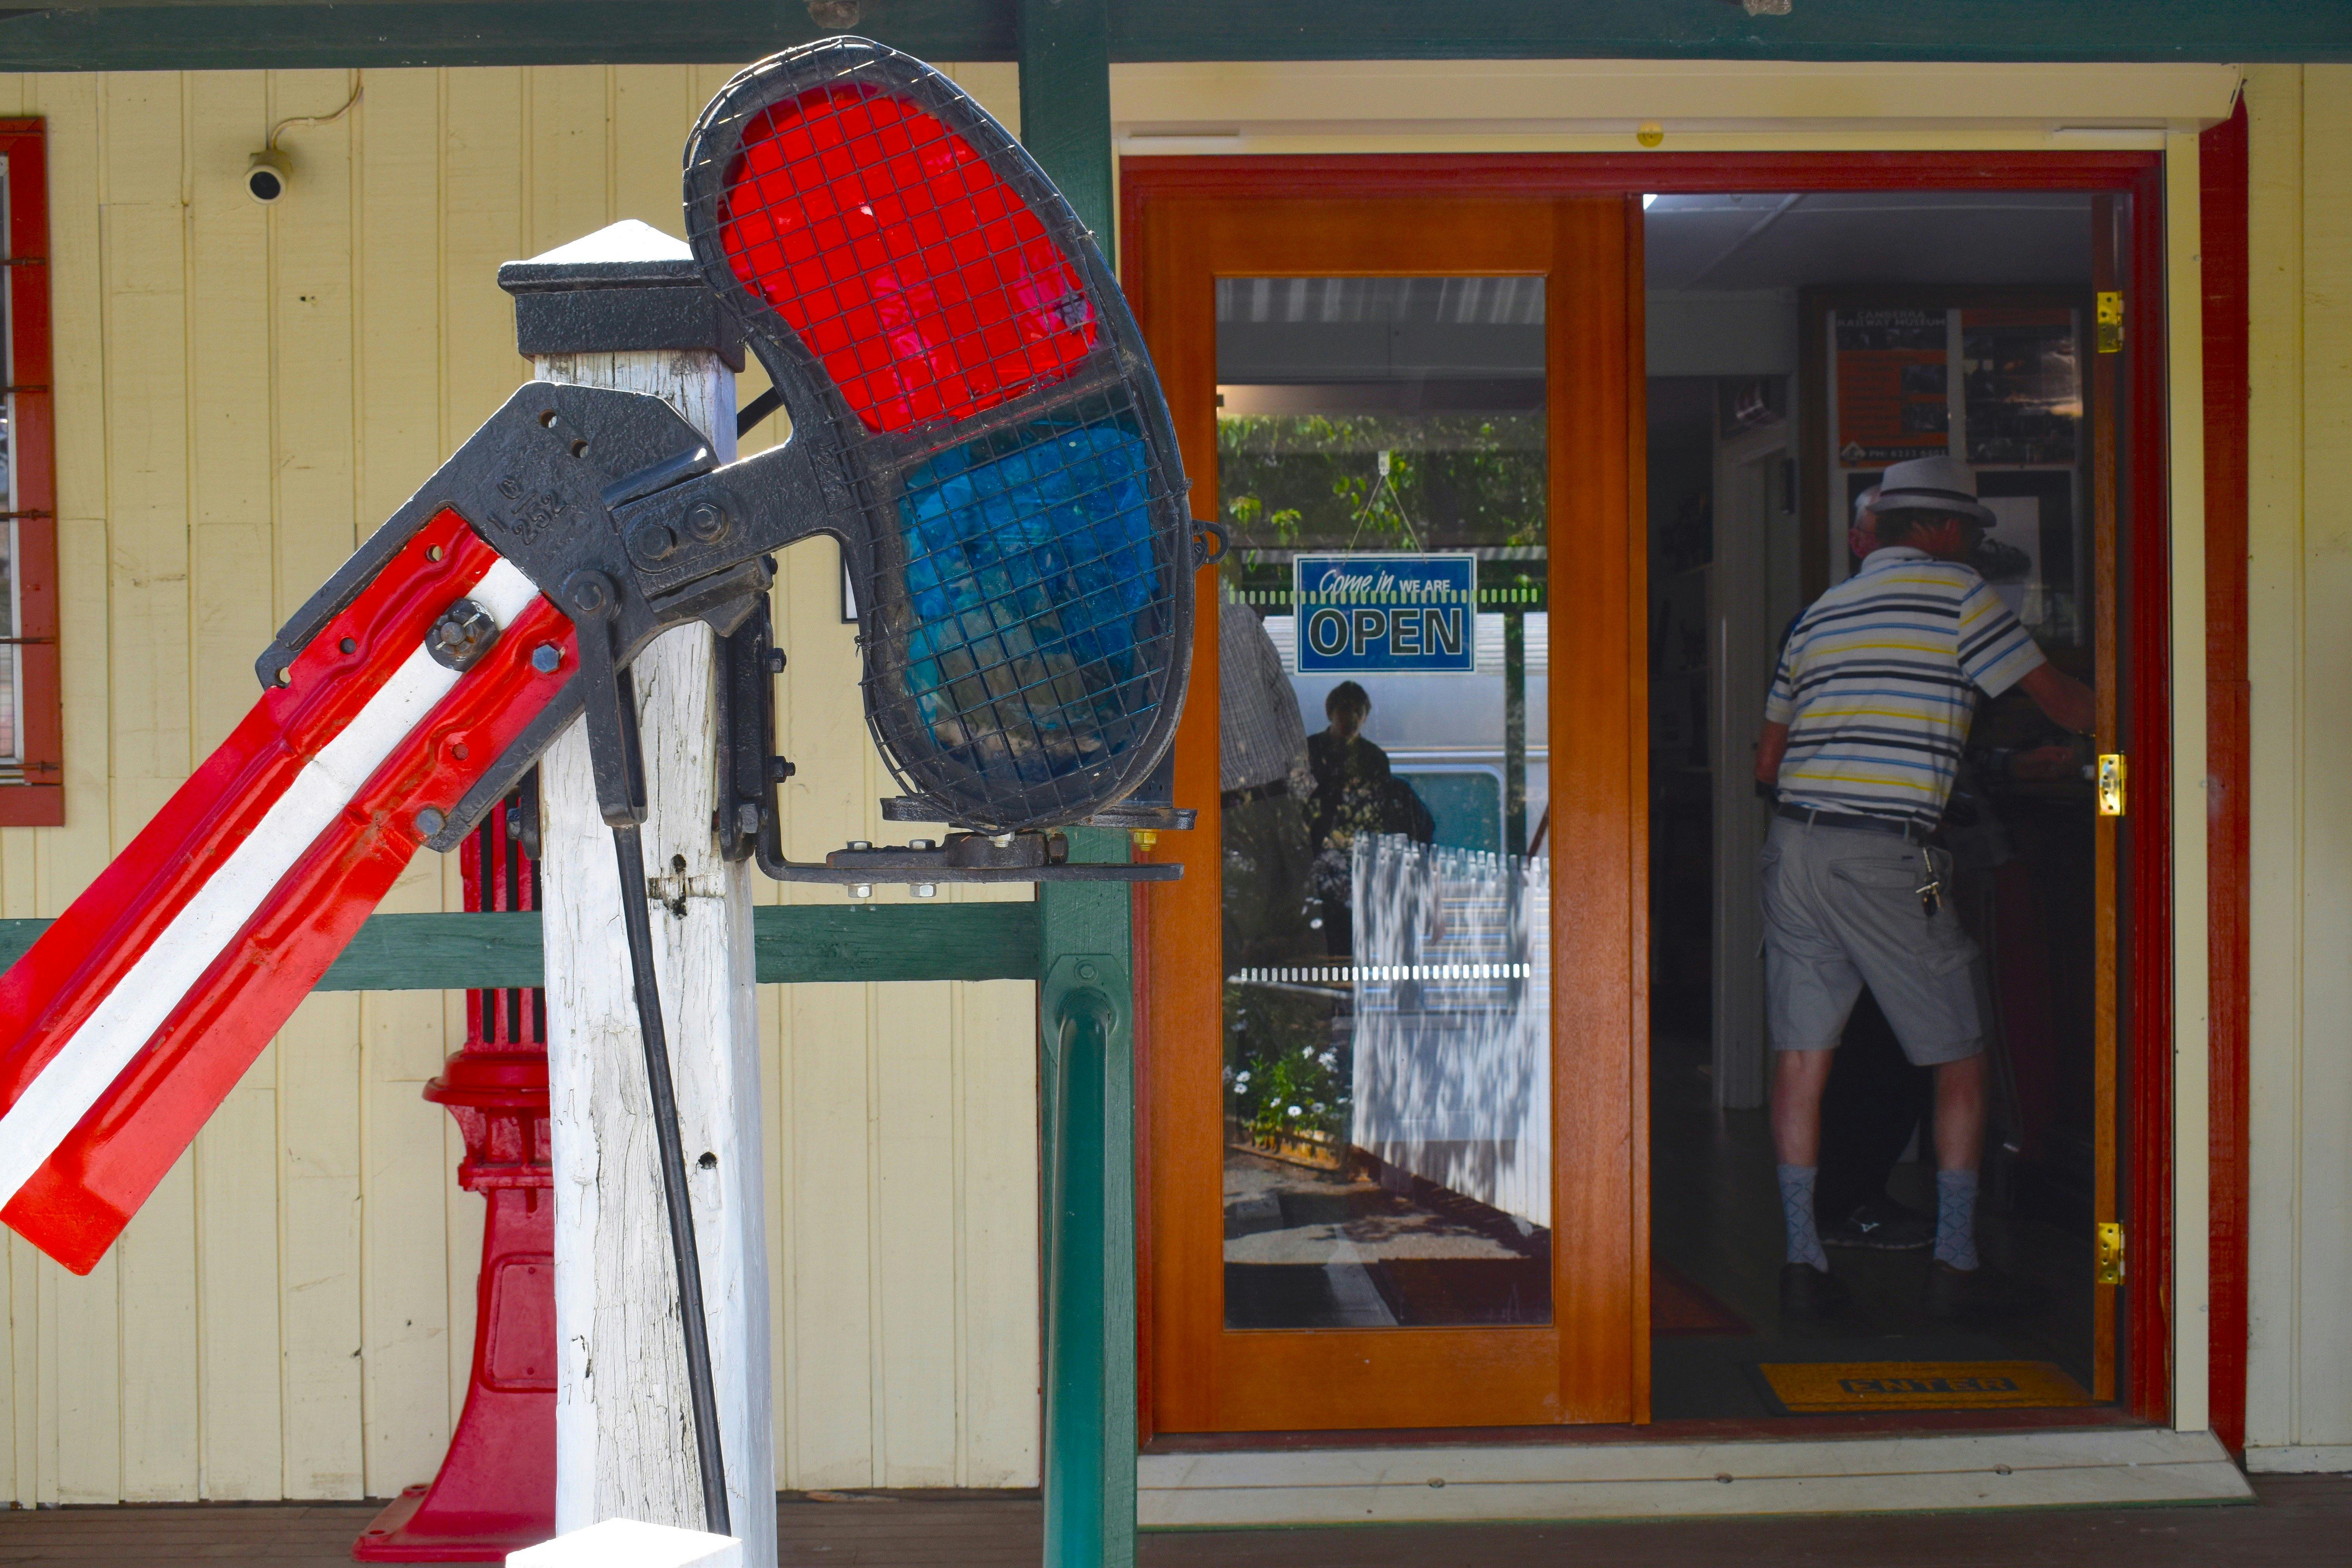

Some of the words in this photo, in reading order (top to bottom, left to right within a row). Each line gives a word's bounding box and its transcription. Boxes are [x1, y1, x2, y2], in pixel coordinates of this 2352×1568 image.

[1857, 310, 1926, 319] CANBERRA
[511, 489, 567, 546] 252
[1319, 569, 1373, 595] Come
[1376, 570, 1395, 594] in
[1399, 580, 1420, 592] WE
[1424, 579, 1451, 593] ARE
[1308, 608, 1463, 657] OPEN
[1849, 1379, 2008, 1392] ENTER
